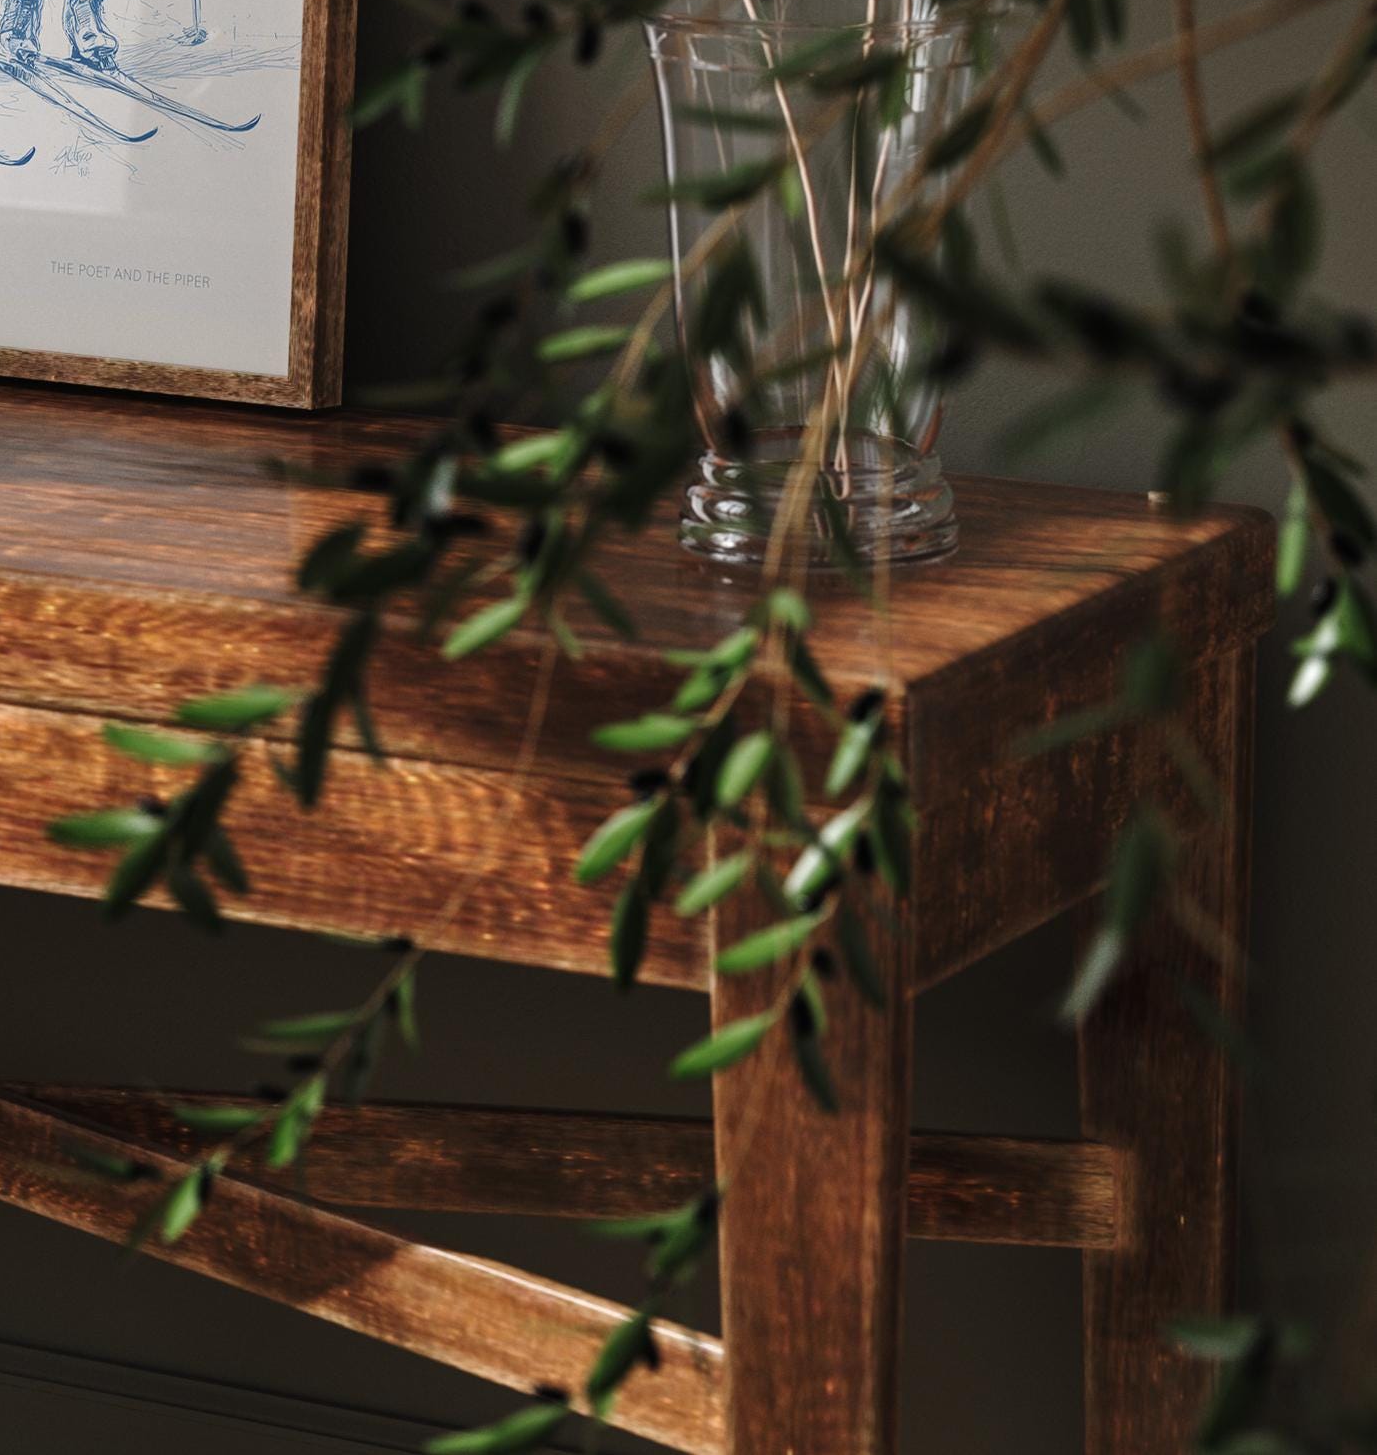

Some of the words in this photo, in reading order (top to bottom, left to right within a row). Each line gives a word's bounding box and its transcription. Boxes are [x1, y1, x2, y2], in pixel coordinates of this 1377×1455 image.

[50, 261, 74, 275] THE
[78, 263, 111, 278] POET
[113, 267, 142, 282] AND
[146, 270, 170, 285] THE
[174, 273, 211, 288] PIPER
